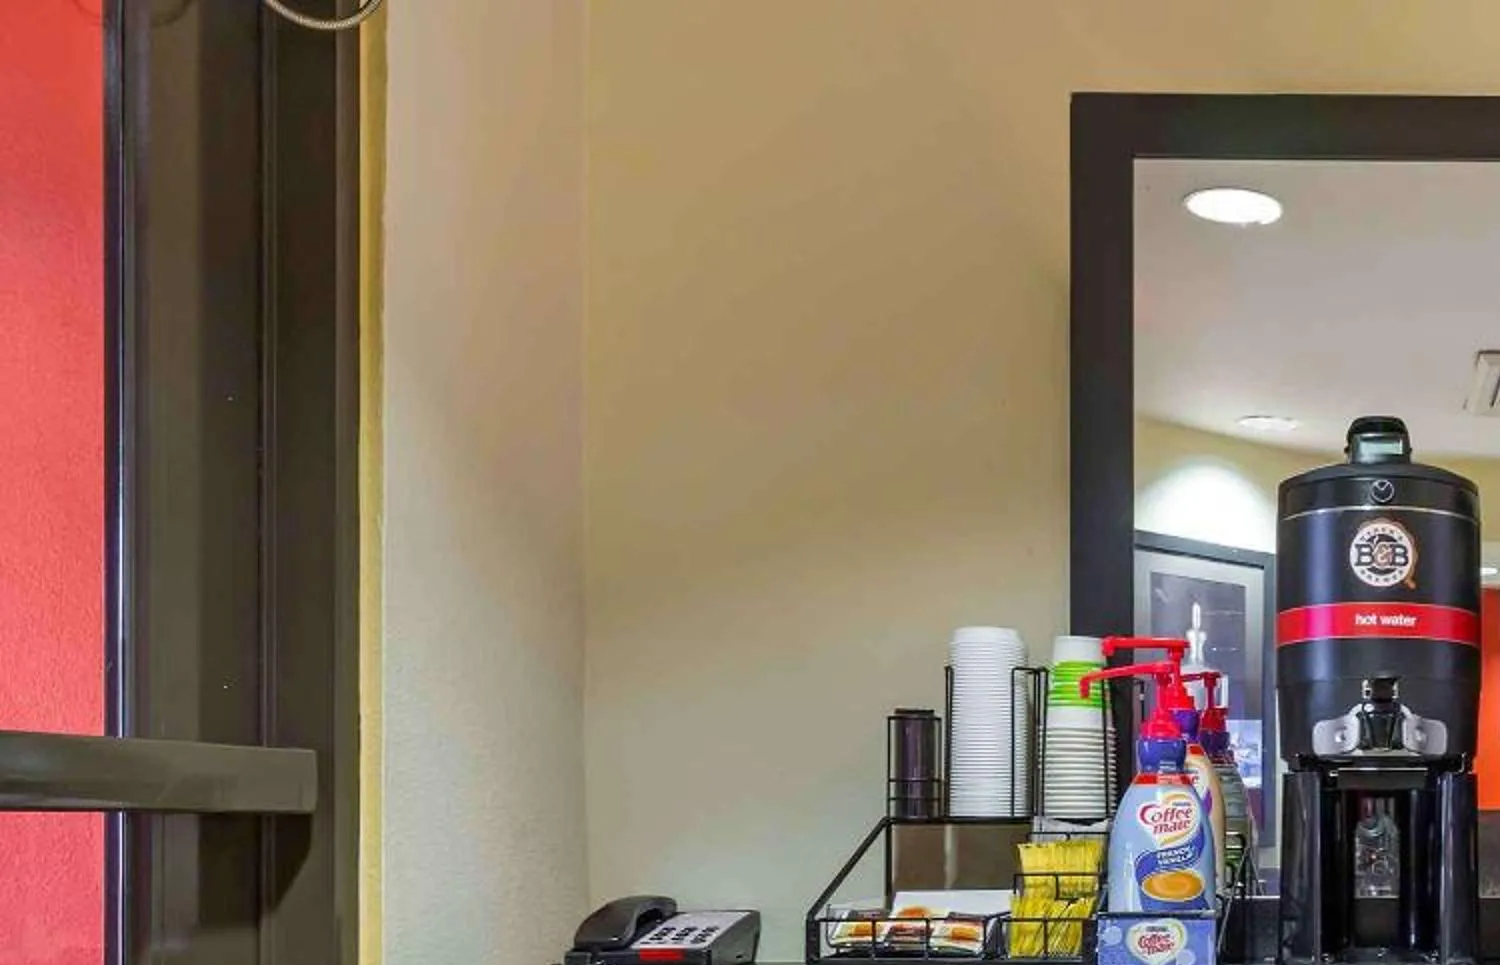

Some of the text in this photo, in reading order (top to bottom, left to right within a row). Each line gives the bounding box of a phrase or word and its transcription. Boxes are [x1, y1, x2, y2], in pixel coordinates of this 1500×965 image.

[1355, 542, 1409, 567] B&B
[1355, 613, 1417, 627] hot water
[1140, 803, 1193, 826] Coffee
[1152, 819, 1192, 835] mate
